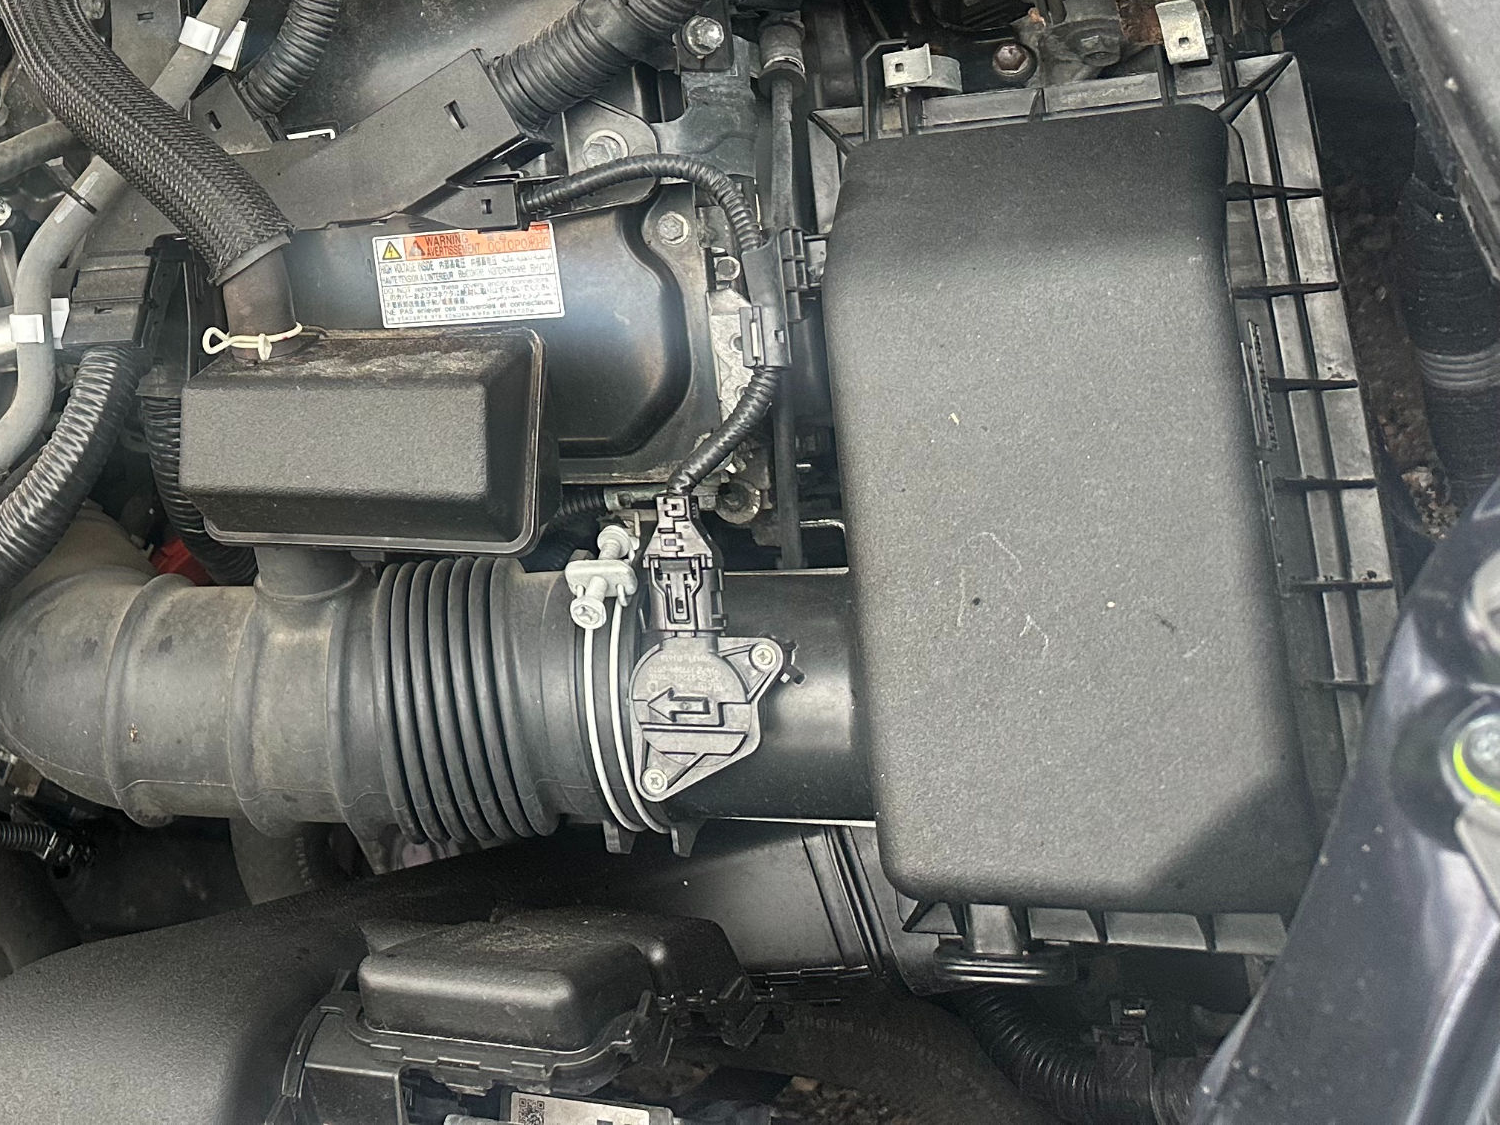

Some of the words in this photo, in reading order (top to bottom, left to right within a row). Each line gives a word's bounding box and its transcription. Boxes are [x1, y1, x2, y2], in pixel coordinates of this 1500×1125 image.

[424, 233, 469, 247] WARNING
[488, 236, 550, 252] ОСТОРОЖНО
[426, 242, 481, 257] AVERTISSEMENT
